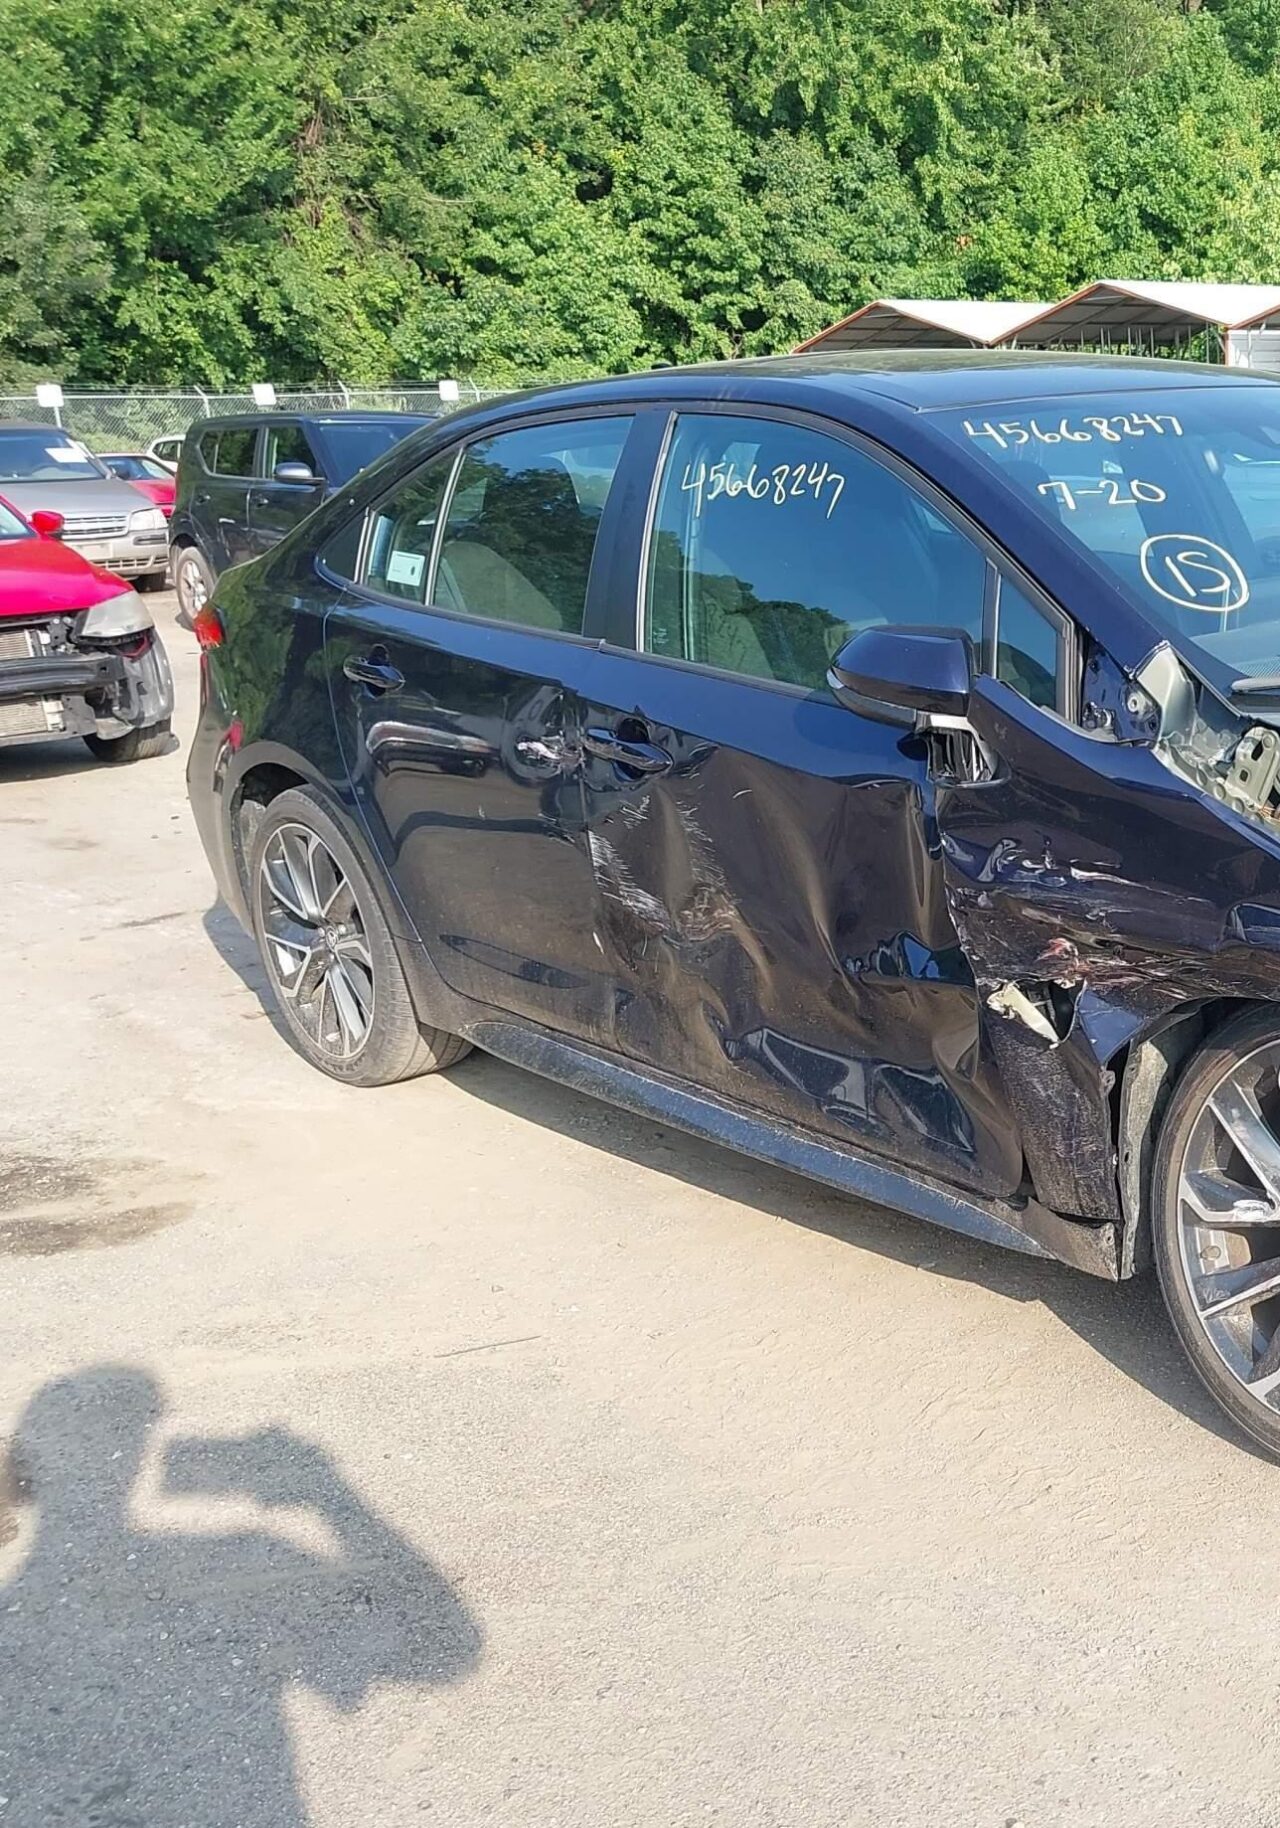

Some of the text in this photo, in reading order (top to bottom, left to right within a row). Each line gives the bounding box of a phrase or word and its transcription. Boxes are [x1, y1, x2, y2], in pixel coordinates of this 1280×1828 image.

[963, 413, 1183, 448] 45668247
[681, 462, 845, 519] 45668247
[1037, 479, 1167, 510] 7-20
